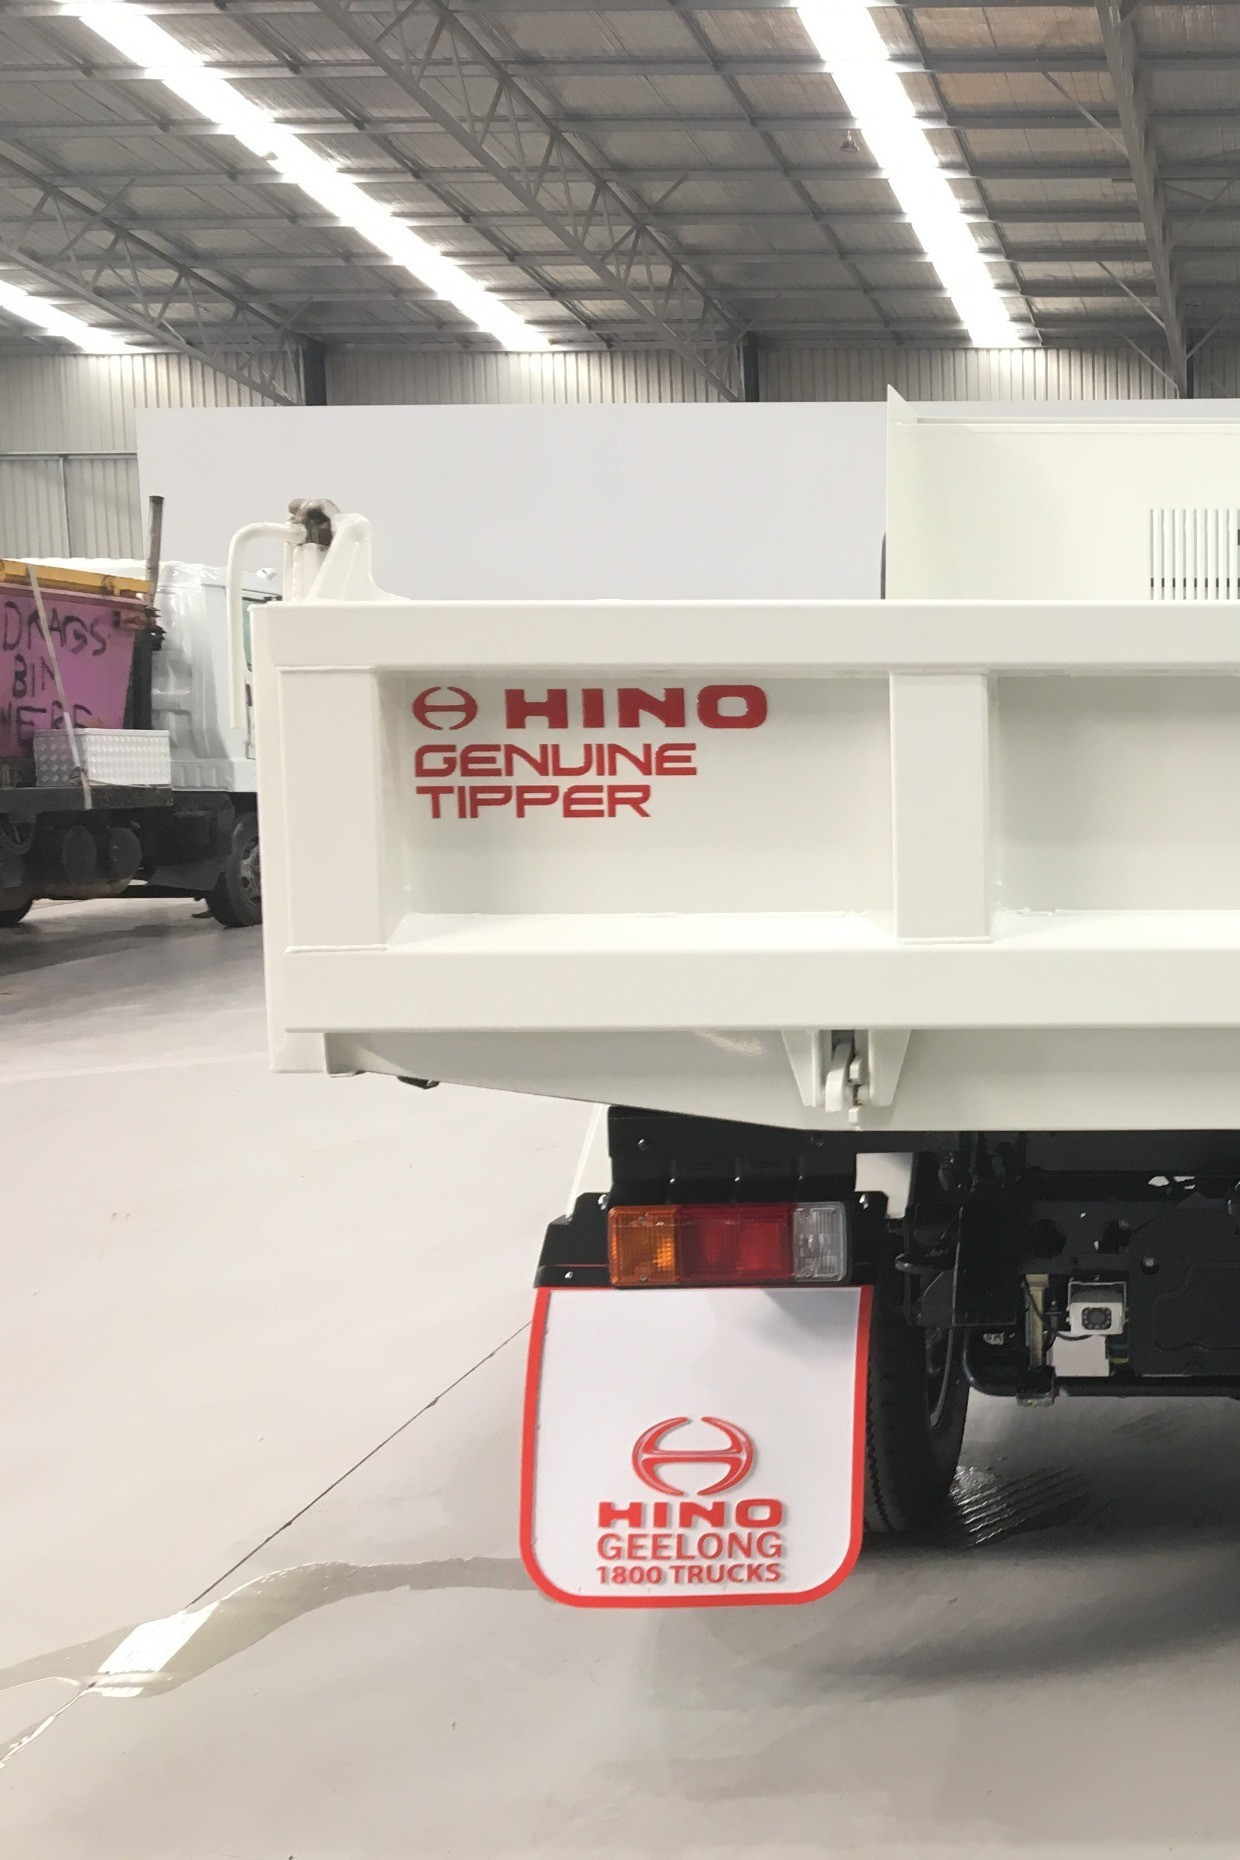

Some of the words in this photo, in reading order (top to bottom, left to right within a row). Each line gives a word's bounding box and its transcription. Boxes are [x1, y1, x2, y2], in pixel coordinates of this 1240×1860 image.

[505, 684, 768, 729] HINO
[415, 743, 697, 777] GENUINE
[416, 784, 652, 819] TIPPER
[597, 1498, 784, 1529] HINO
[596, 1531, 783, 1561] GEELONG
[596, 1565, 663, 1585] 1800
[668, 1562, 782, 1585] TRUCKS
